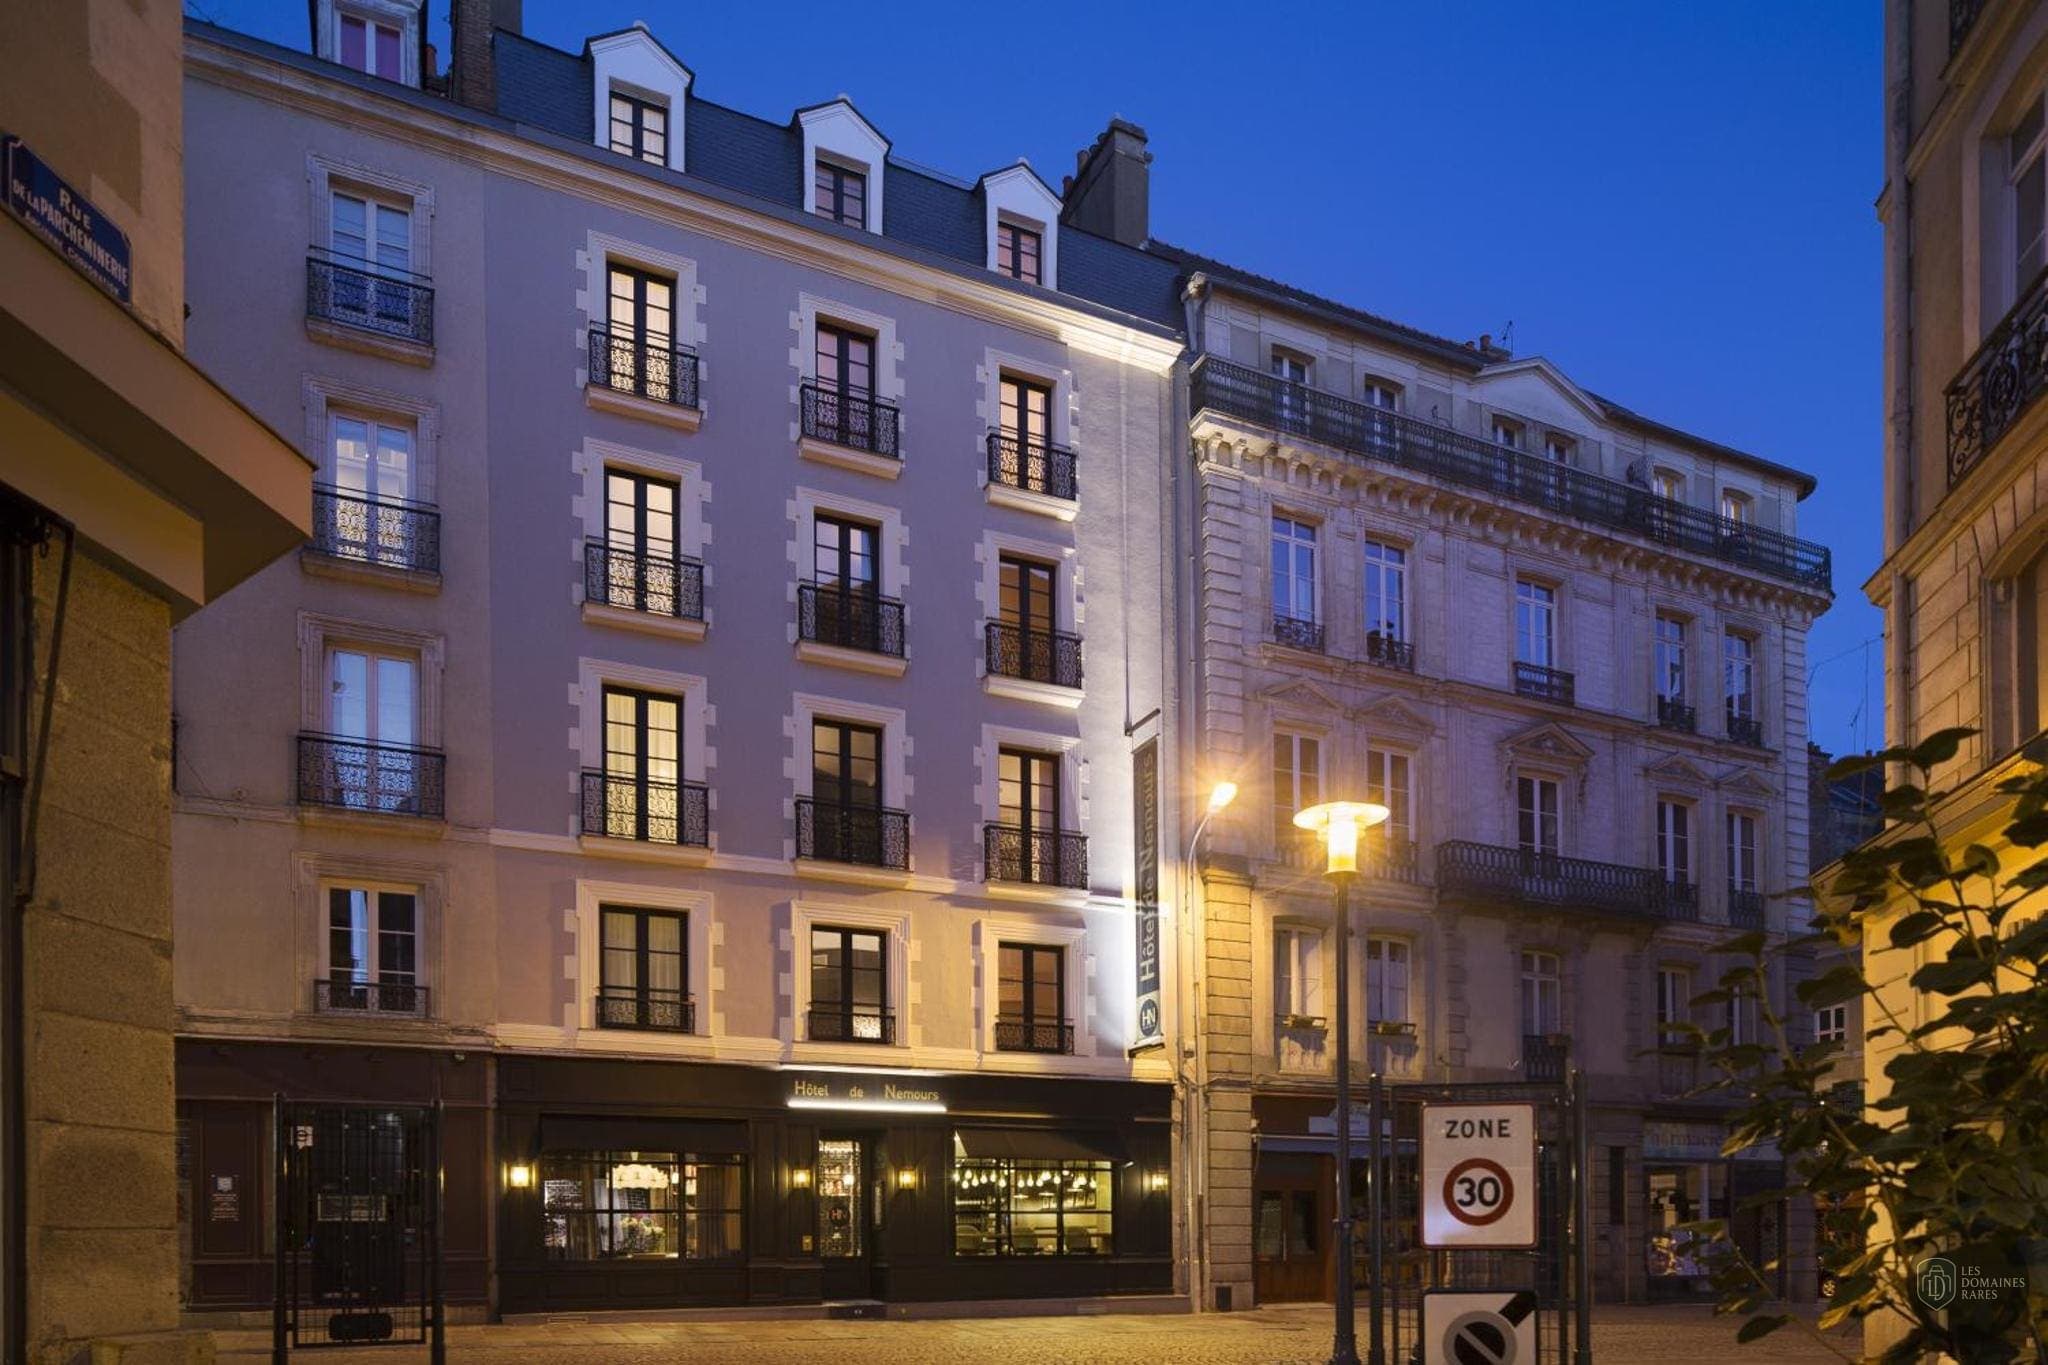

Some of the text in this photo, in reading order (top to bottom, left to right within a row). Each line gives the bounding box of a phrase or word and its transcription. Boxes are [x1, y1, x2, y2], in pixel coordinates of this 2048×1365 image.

[12, 179, 129, 287] DE LA PARCHEMINERIE
[1140, 753, 1155, 982] Hôtel de Nemours
[794, 1081, 940, 1101] Hôtel de Nemours
[1445, 1119, 1511, 1139] ZONE
[1456, 1176, 1501, 1207] 30
